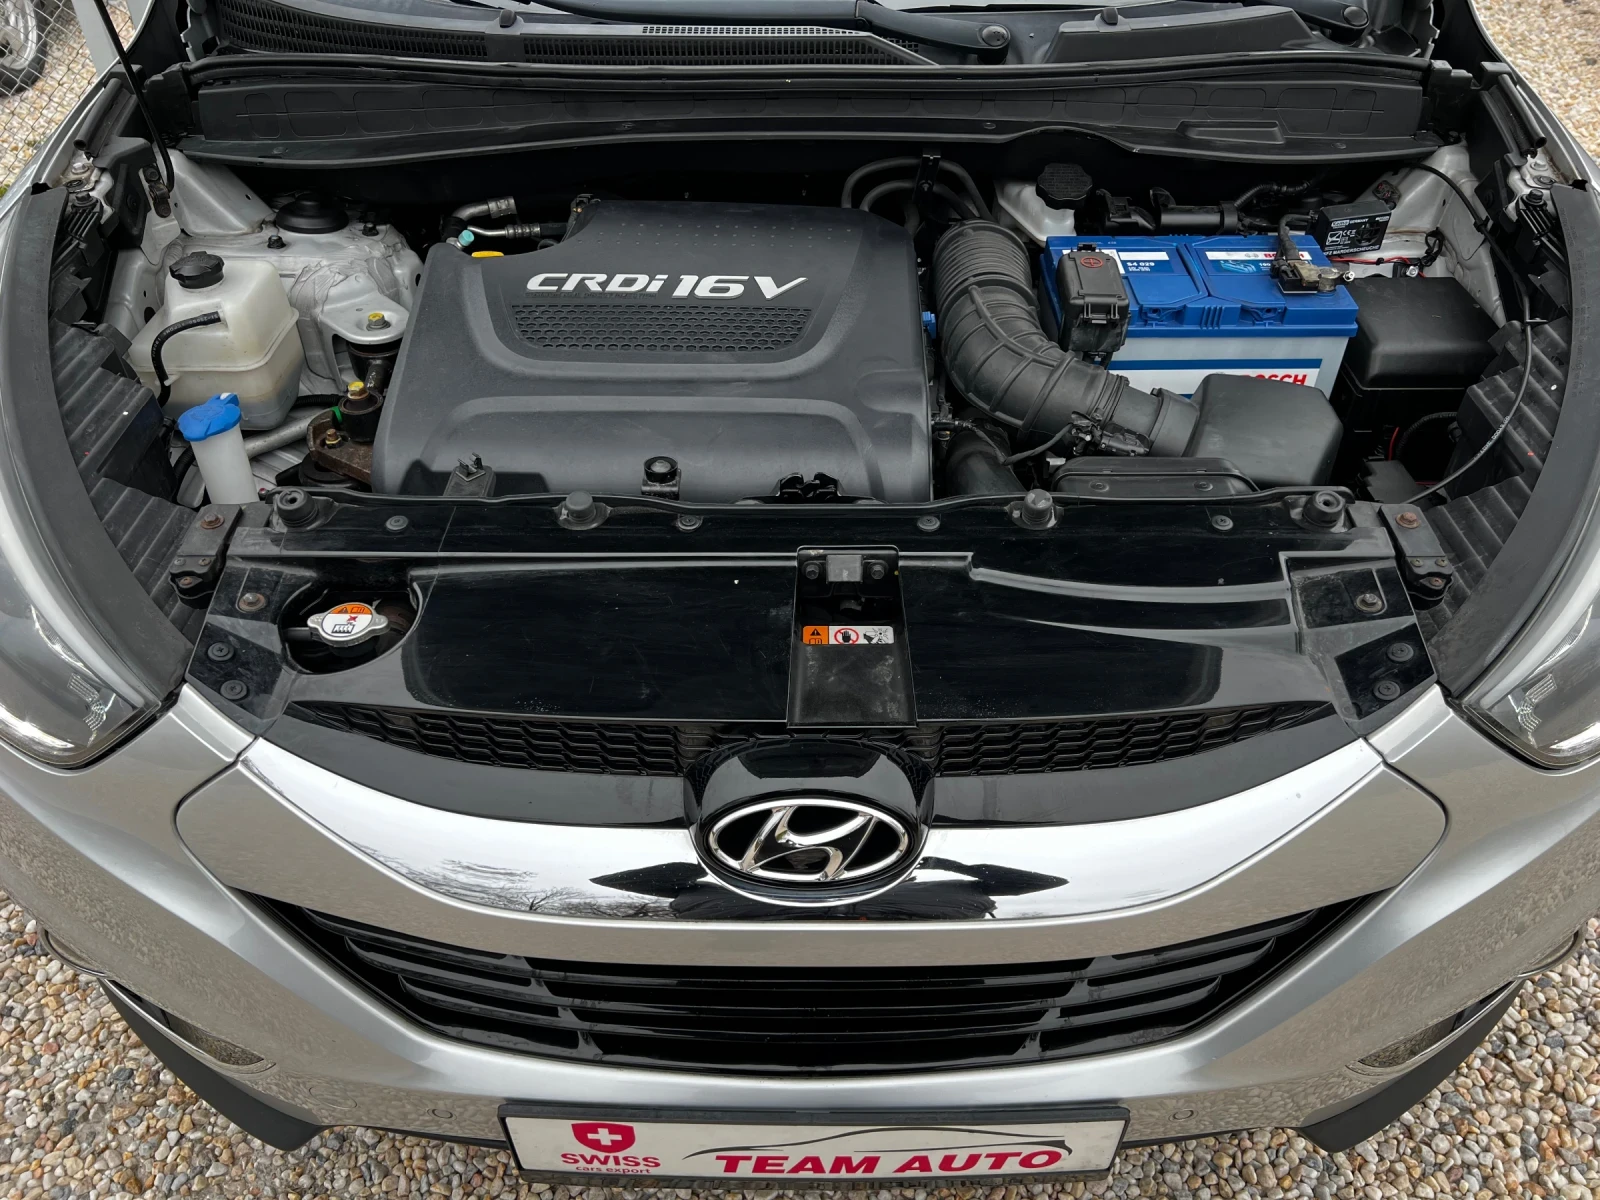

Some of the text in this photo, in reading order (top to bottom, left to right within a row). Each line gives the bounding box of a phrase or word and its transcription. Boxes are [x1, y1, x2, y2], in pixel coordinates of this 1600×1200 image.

[526, 273, 808, 300] CRDi 16V
[560, 1152, 661, 1168] SWISS
[715, 1150, 1063, 1175] TEAM AUTO
[606, 1167, 652, 1175] export
